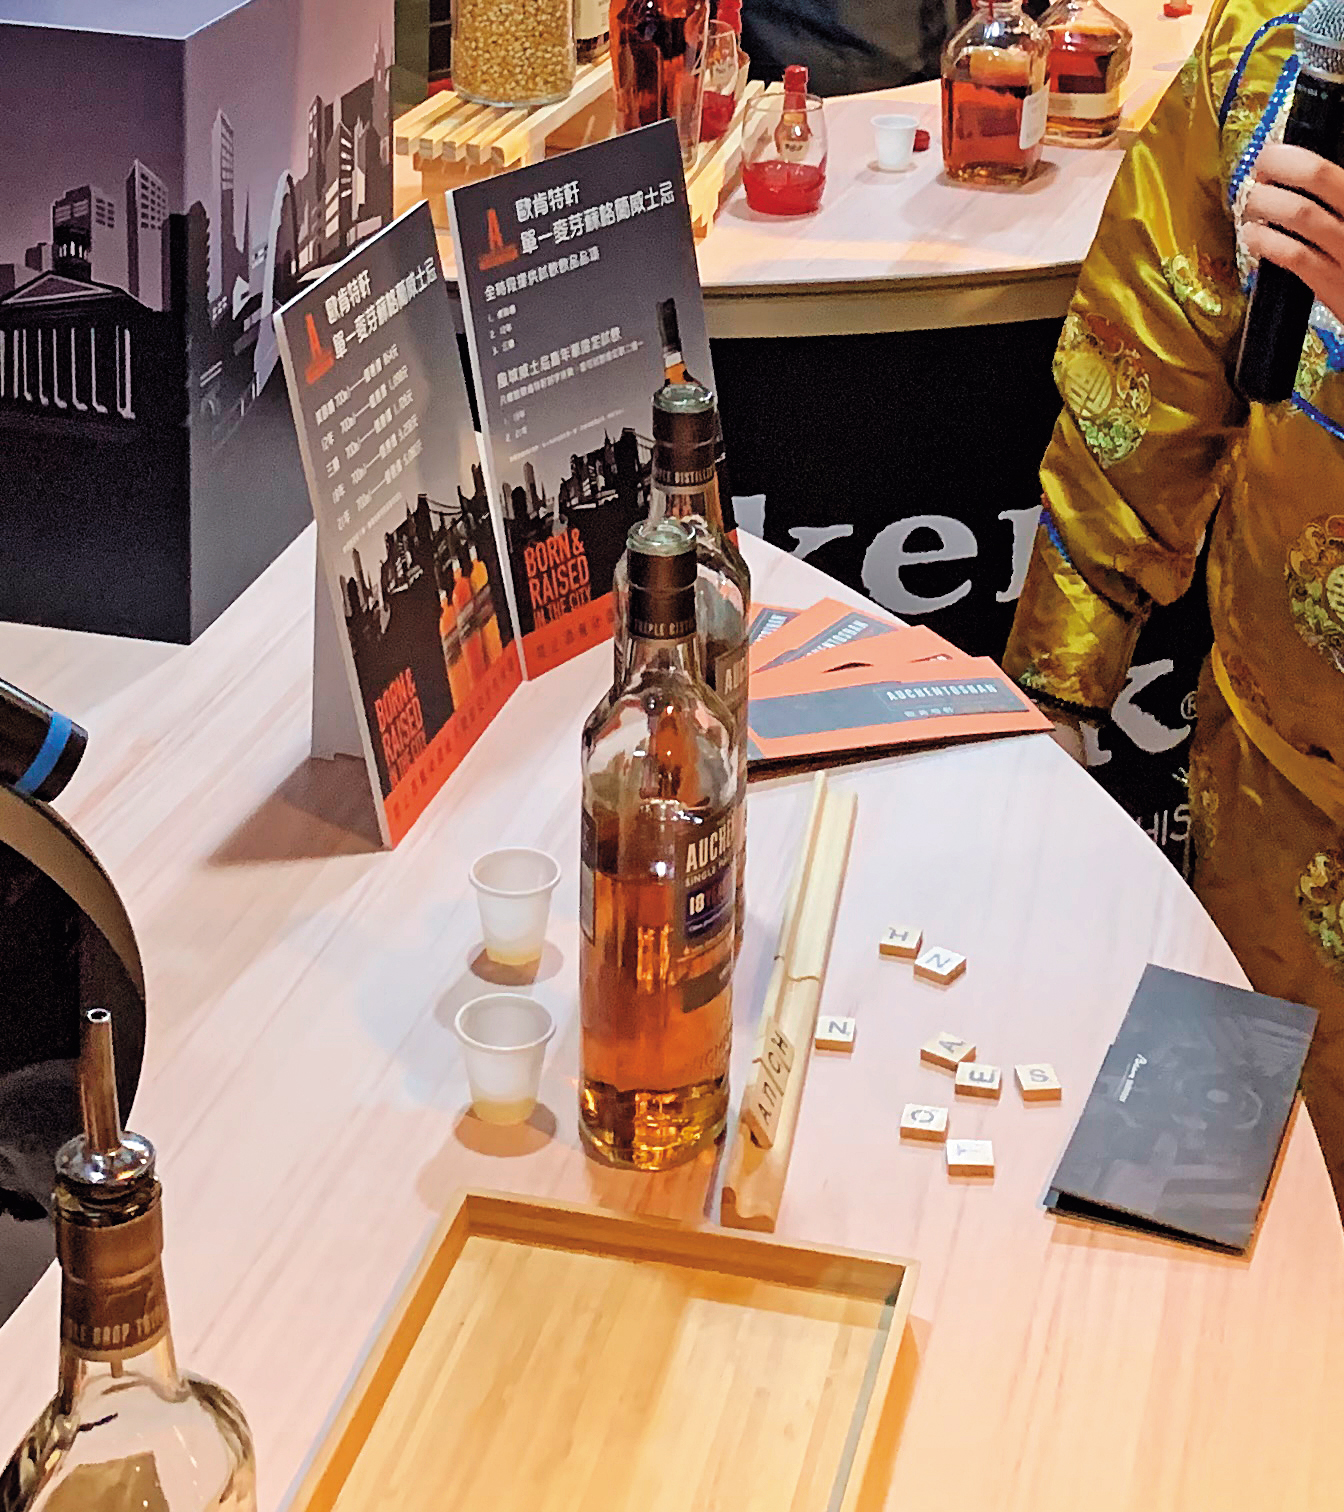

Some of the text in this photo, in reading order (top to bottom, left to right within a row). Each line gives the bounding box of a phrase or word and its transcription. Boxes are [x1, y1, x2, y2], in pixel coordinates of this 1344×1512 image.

[524, 527, 585, 577] BORN &
[529, 555, 589, 607] RAISED
[374, 672, 408, 734] BORN
[886, 684, 998, 702] AUCHENTOSHAN
[382, 696, 424, 767] RAISED
[689, 892, 705, 916] 18
[1029, 1068, 1050, 1083] S
